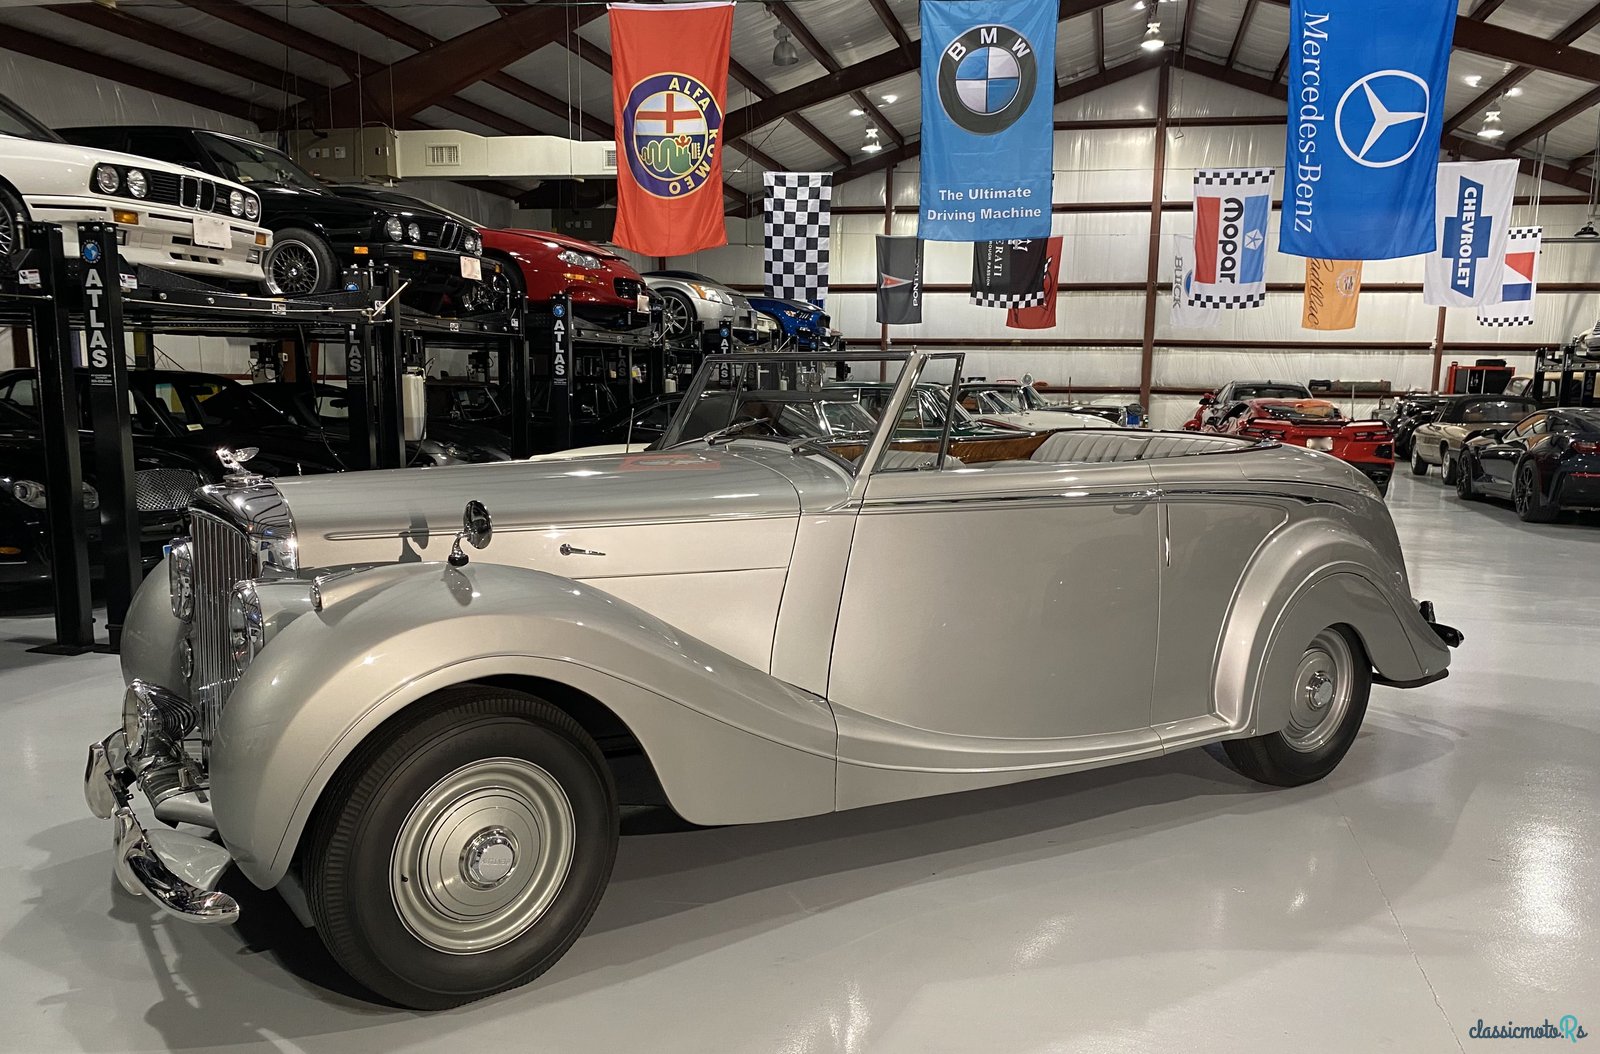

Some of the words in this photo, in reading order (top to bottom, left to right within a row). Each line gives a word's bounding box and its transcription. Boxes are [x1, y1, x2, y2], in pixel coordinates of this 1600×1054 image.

[947, 27, 1031, 62] BMW
[669, 77, 712, 112] ALFA
[1294, 11, 1329, 233] Mercedes-Benz
[927, 209, 976, 223] Driving
[980, 207, 1042, 219] Machine
[939, 190, 963, 201] The
[968, 187, 1032, 200] Ultimate
[993, 240, 1005, 277] ERATI
[1457, 186, 1478, 288] CHEVROLET
[1173, 255, 1184, 309] BUICK
[85, 268, 108, 368] ATLAS
[348, 323, 362, 373] LAS
[553, 319, 566, 376] ATLAS
[720, 338, 729, 378] ATAS
